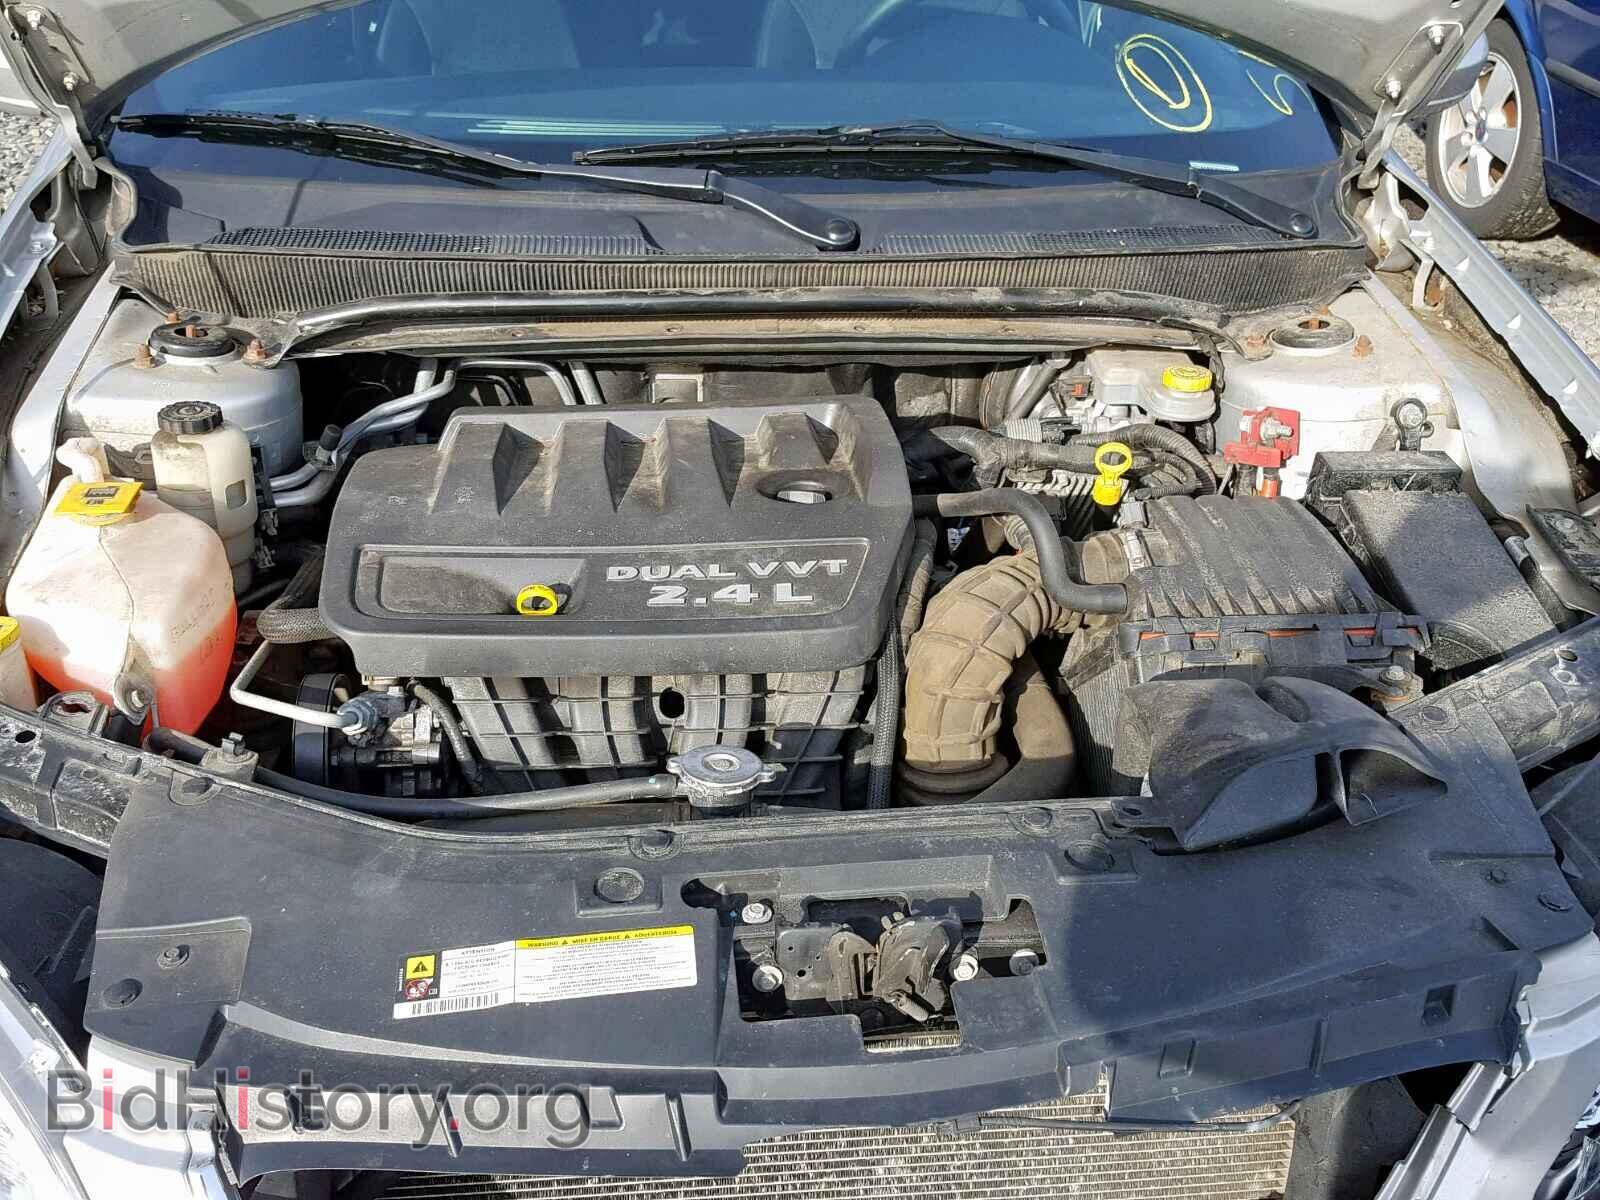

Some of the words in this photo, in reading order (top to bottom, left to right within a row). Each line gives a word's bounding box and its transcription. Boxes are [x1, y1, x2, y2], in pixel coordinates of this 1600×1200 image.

[606, 563, 737, 581] DUAL
[747, 559, 848, 578] VVT
[647, 583, 760, 607] 2.4
